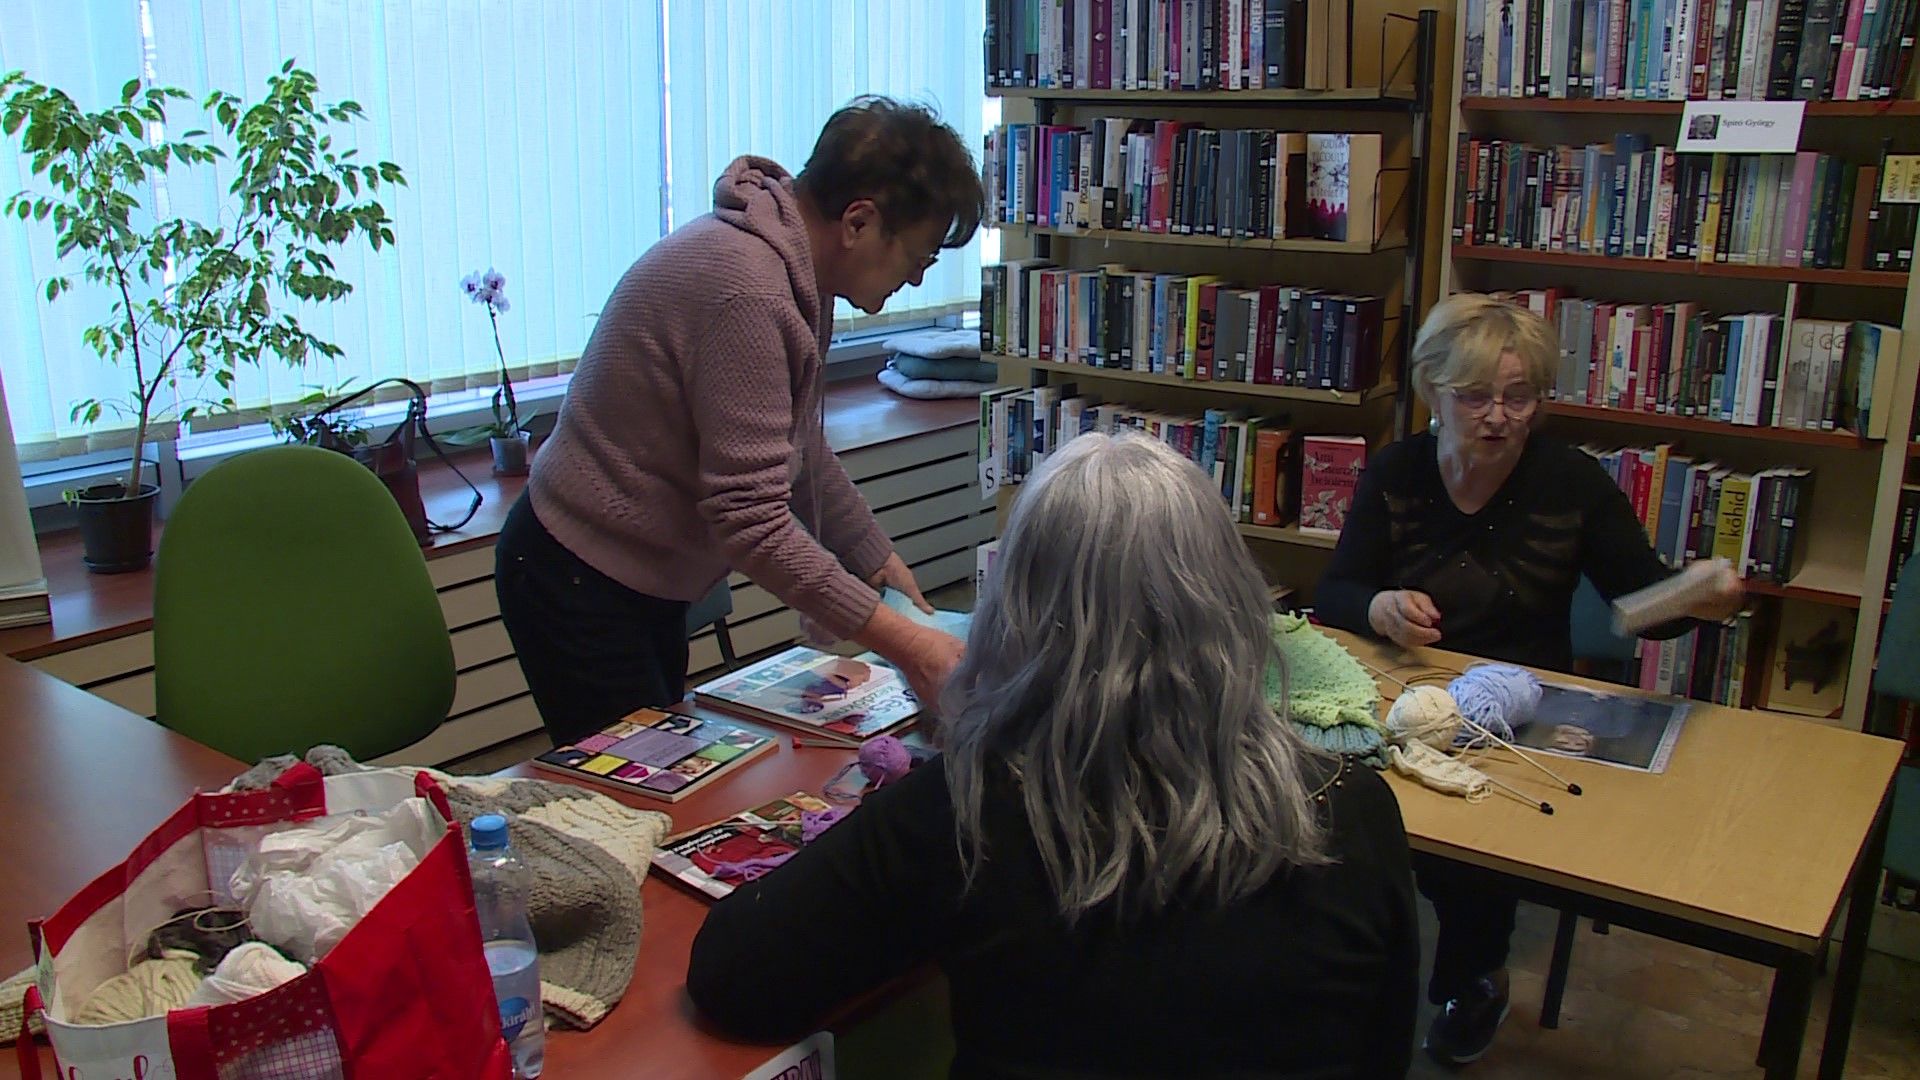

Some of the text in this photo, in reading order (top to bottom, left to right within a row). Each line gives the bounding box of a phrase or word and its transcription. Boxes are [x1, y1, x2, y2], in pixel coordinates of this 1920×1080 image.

[1745, 118, 1775, 129] György
[1065, 201, 1074, 225] R
[985, 466, 995, 489] S
